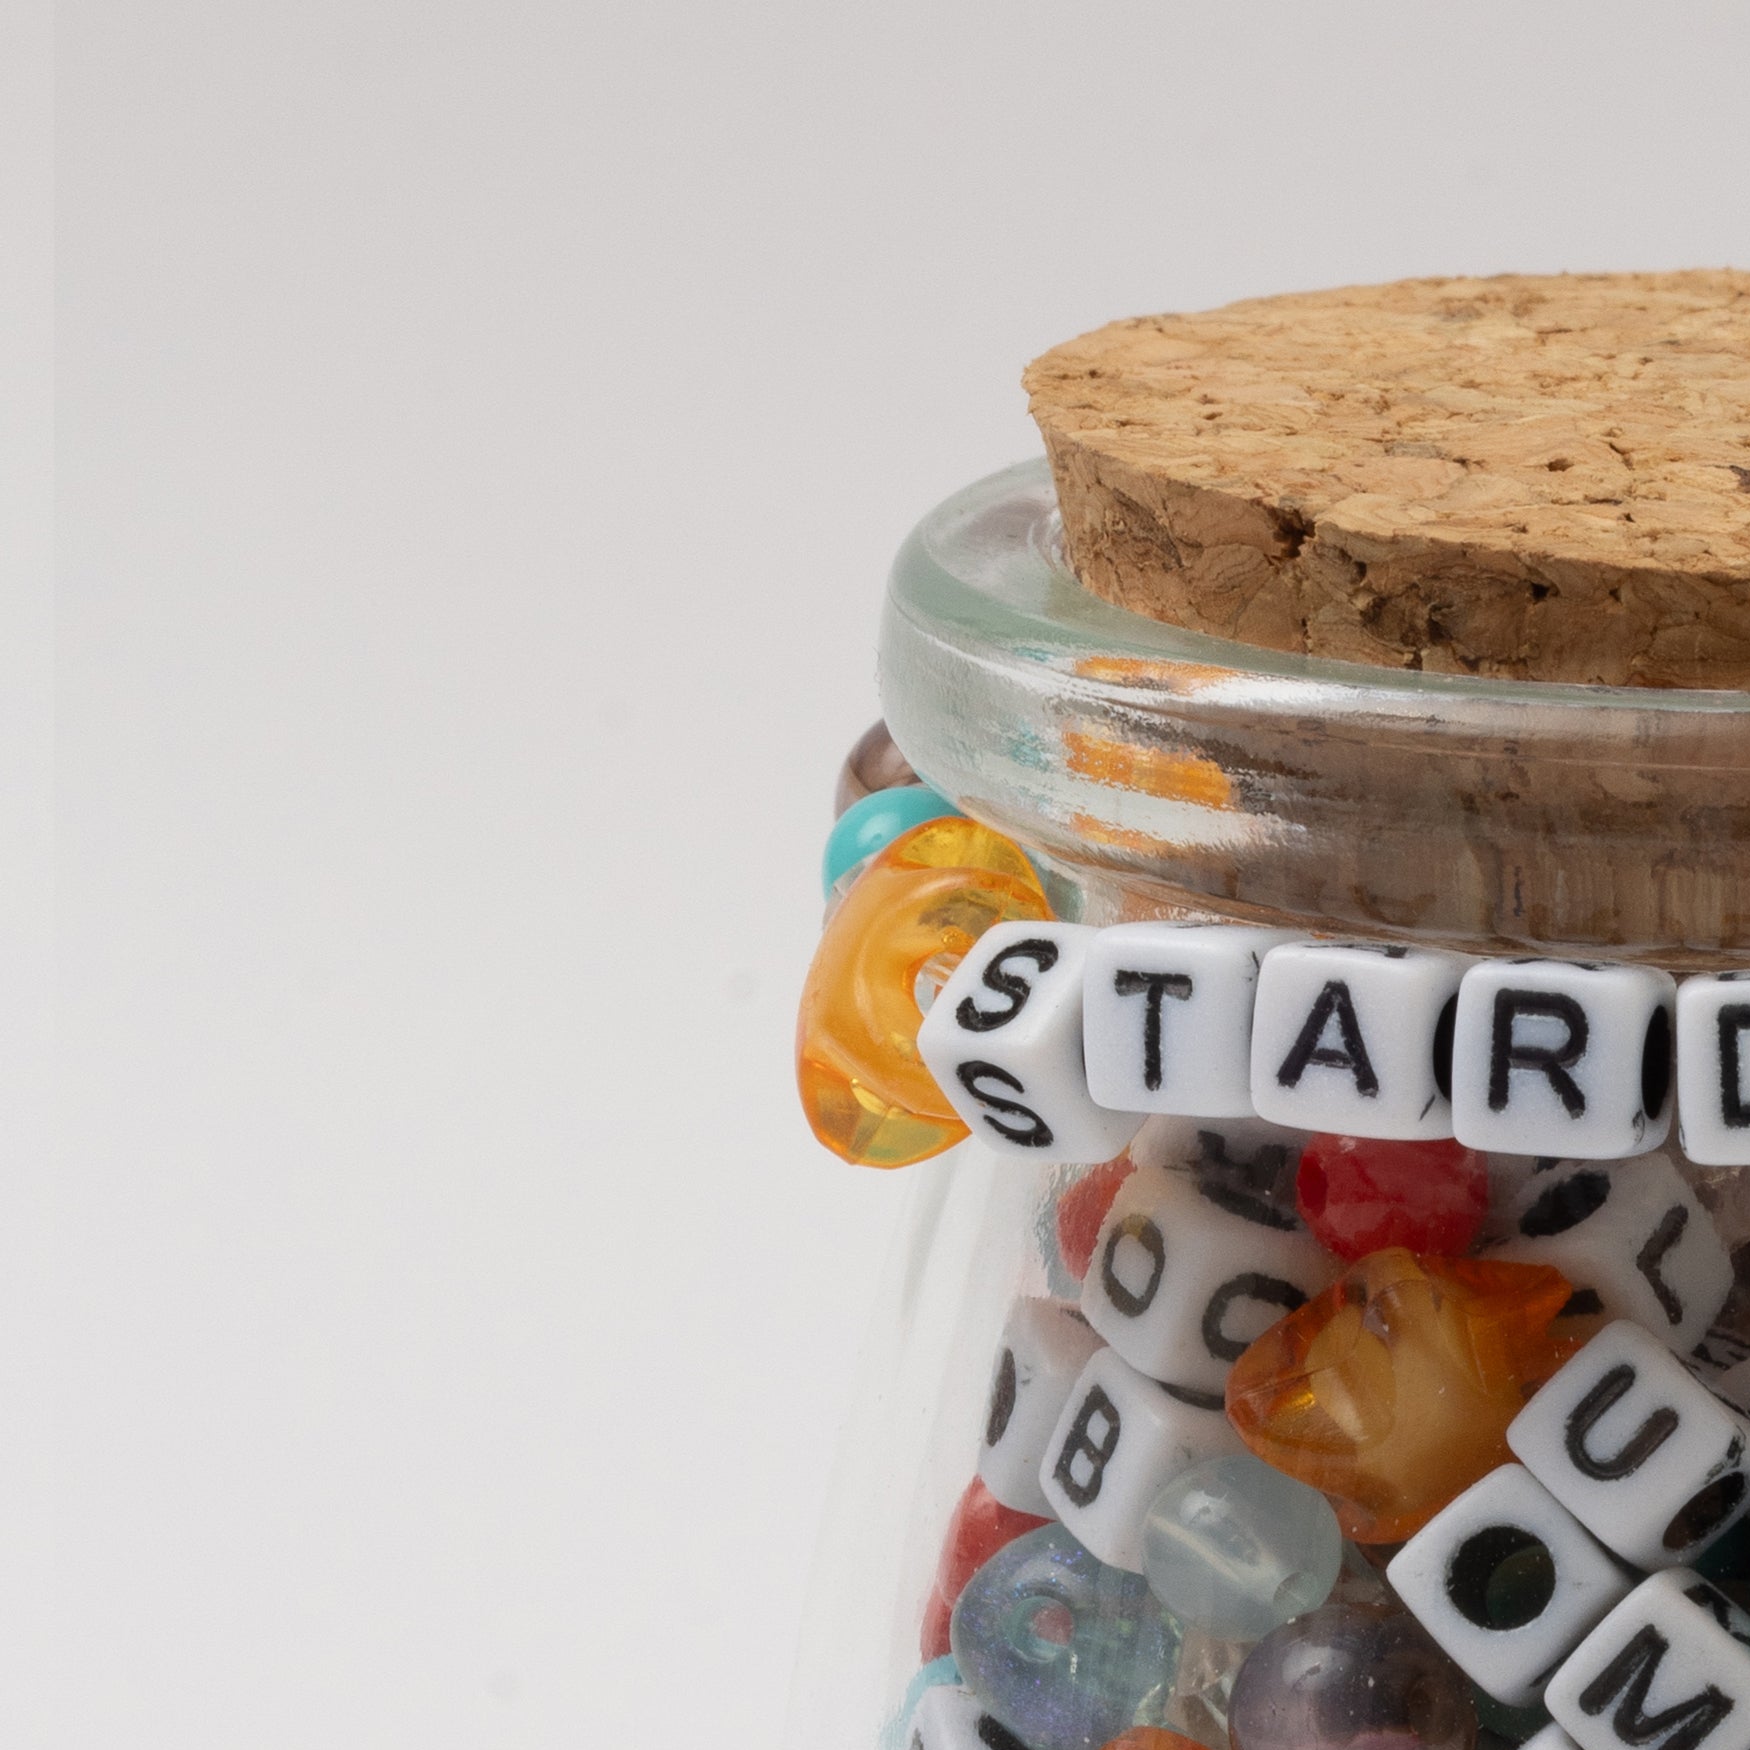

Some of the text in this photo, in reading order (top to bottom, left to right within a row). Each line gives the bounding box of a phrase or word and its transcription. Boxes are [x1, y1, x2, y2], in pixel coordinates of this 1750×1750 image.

[955, 1059, 1056, 1149] S
[1053, 1382, 1121, 1509] B
[1563, 1363, 1680, 1482] U
